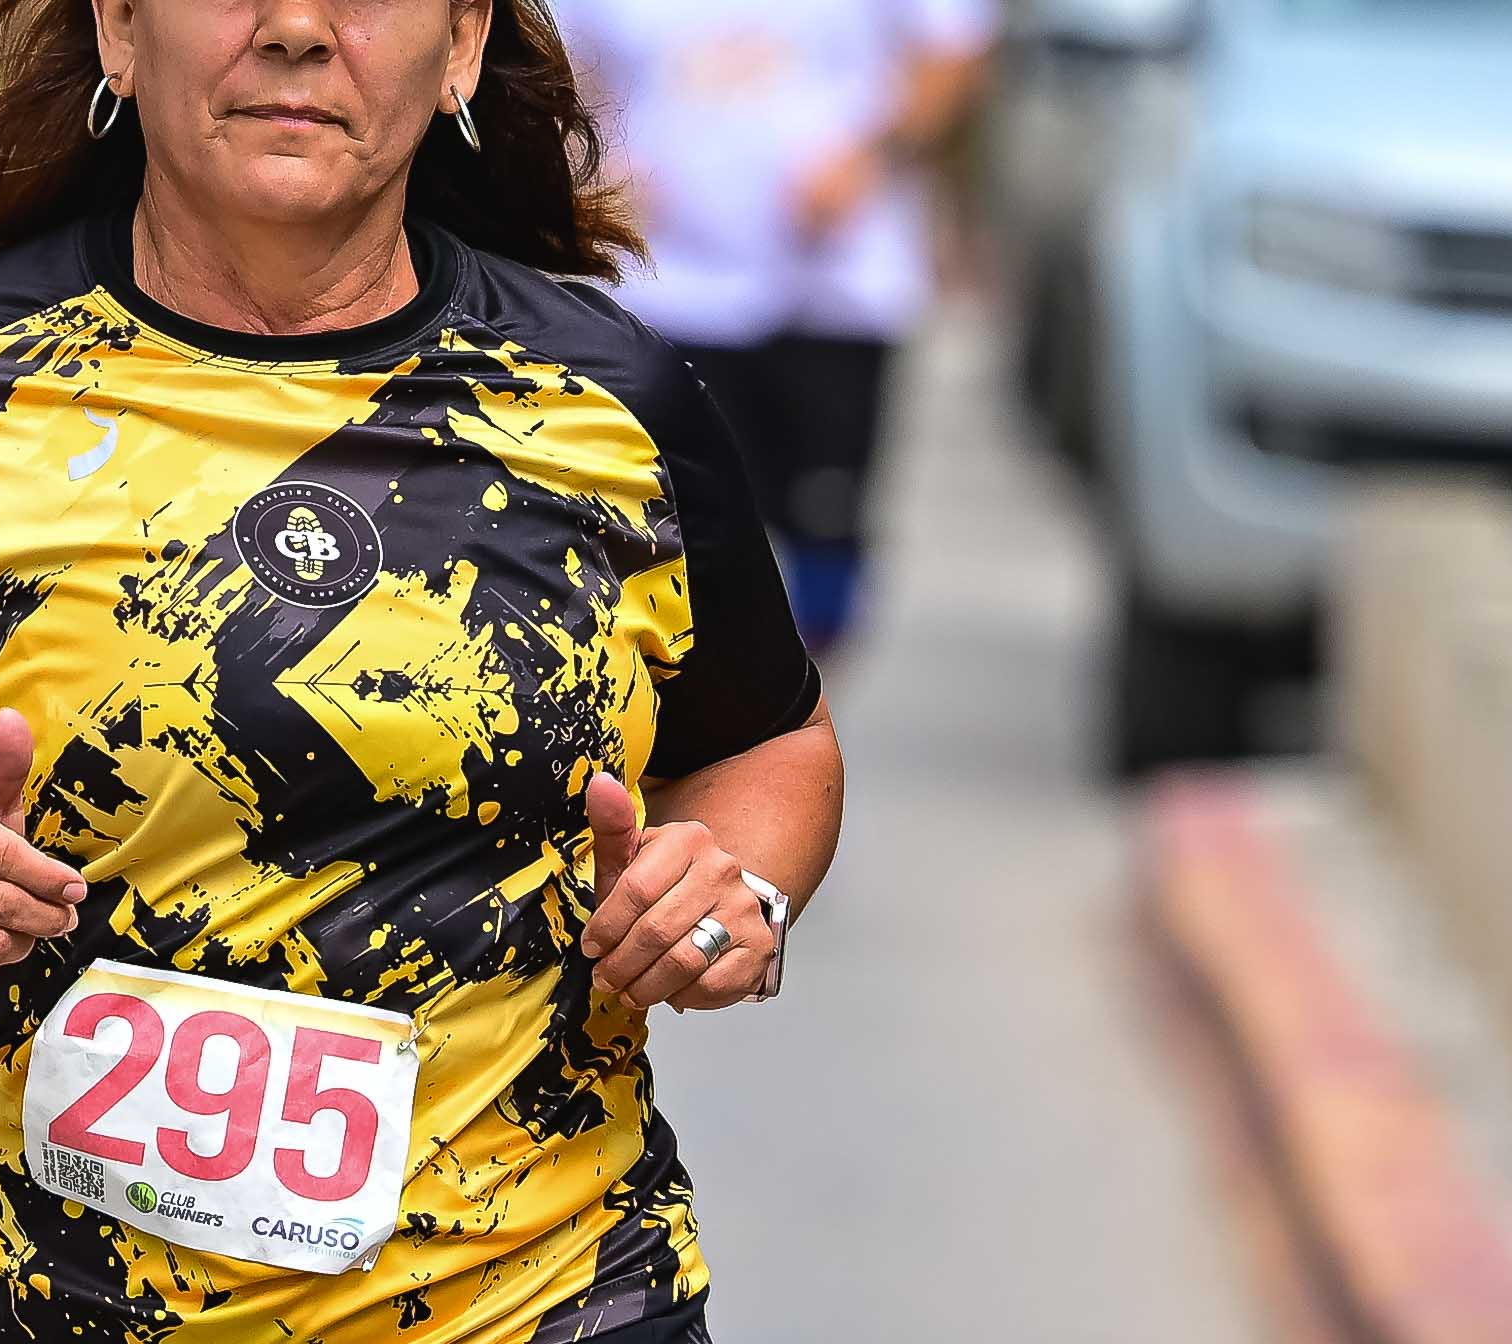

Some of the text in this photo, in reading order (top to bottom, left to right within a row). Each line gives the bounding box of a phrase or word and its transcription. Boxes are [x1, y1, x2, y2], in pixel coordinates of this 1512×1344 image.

[252, 489, 312, 510] TRAINING
[252, 556, 301, 595] RUNNING
[310, 590, 335, 598] AND
[48, 992, 383, 1202] 295
[160, 1191, 196, 1209] CLUB
[157, 1203, 224, 1228] RUNNER'S
[251, 1216, 360, 1251] CARUSO
